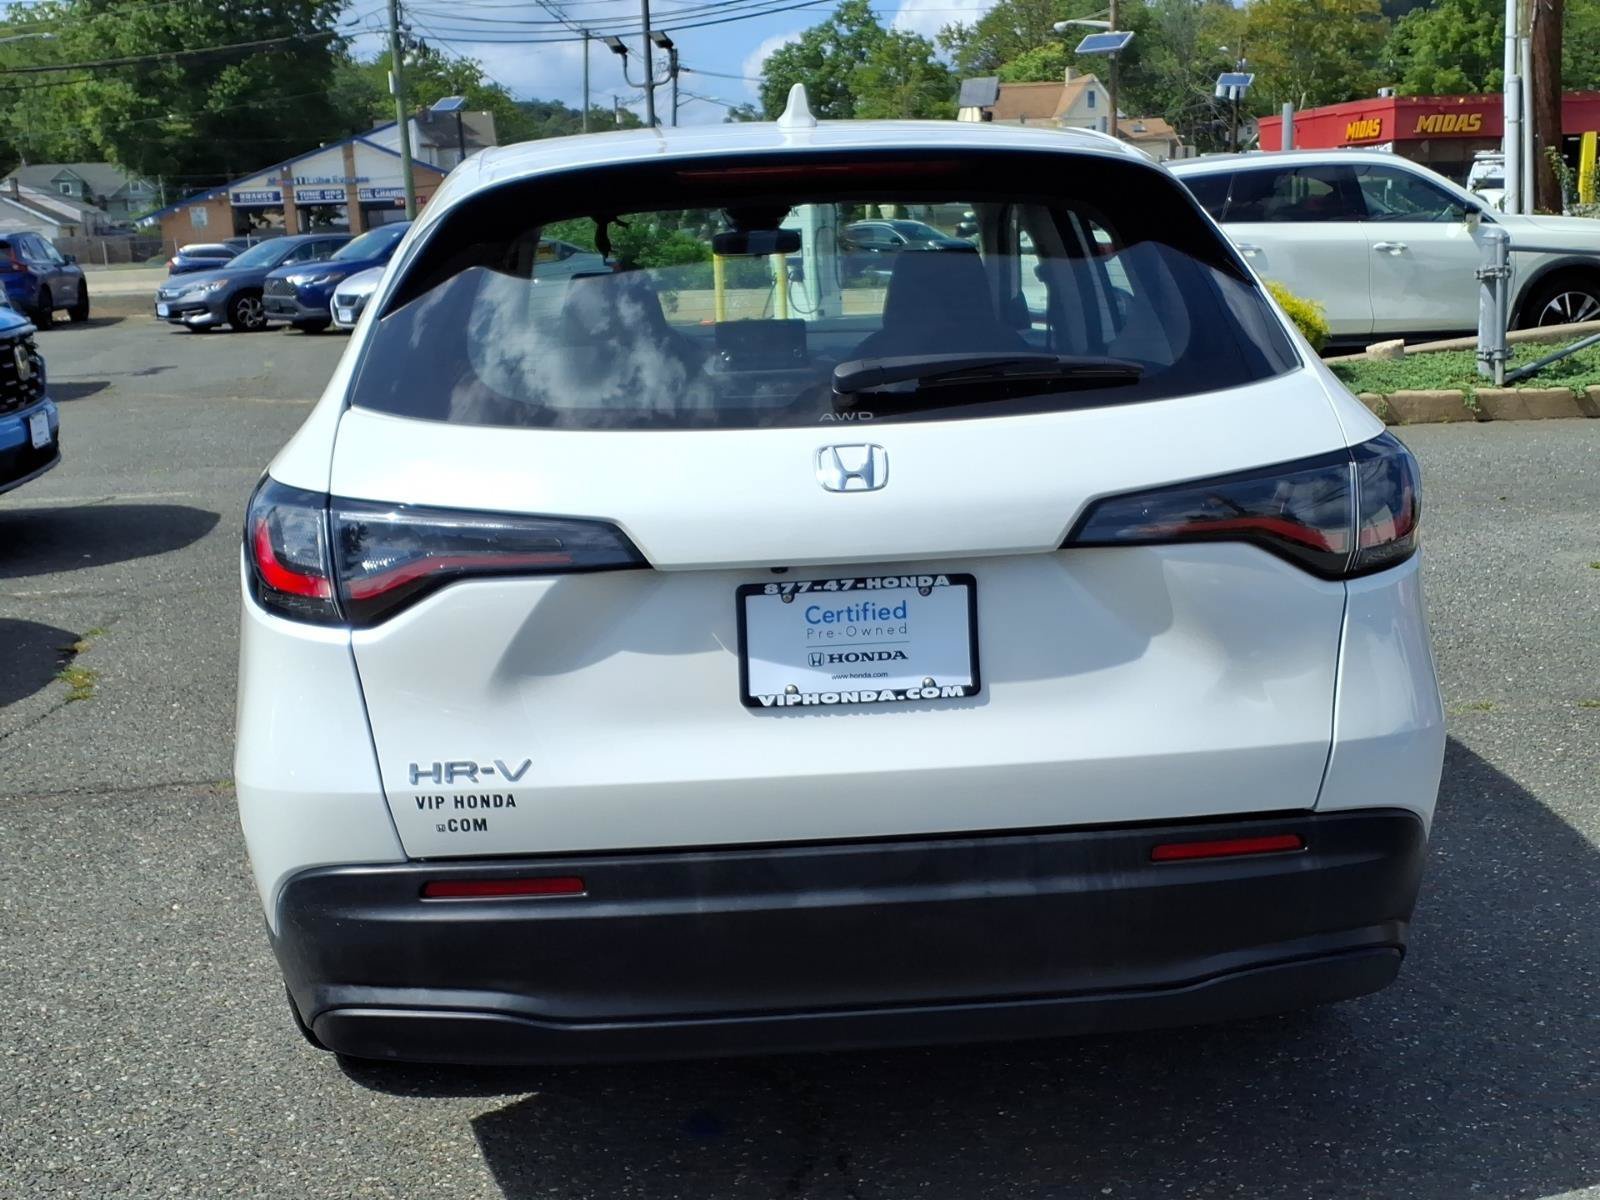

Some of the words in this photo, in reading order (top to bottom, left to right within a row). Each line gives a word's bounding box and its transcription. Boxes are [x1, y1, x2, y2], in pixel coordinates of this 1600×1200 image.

[1345, 118, 1381, 140] MIDAS
[1413, 113, 1482, 133] MIDAS
[819, 411, 874, 422] AWD
[763, 575, 951, 595] 877-47-HONDA
[805, 600, 907, 624] Certified
[806, 622, 907, 639] Pre-Owned
[827, 649, 909, 664] HONDA
[831, 671, 889, 680] www.honda.com
[757, 685, 965, 707] VIPHONDA.COM
[408, 758, 533, 785] HR-V
[415, 796, 445, 810] VIP
[453, 793, 516, 809] HONDA
